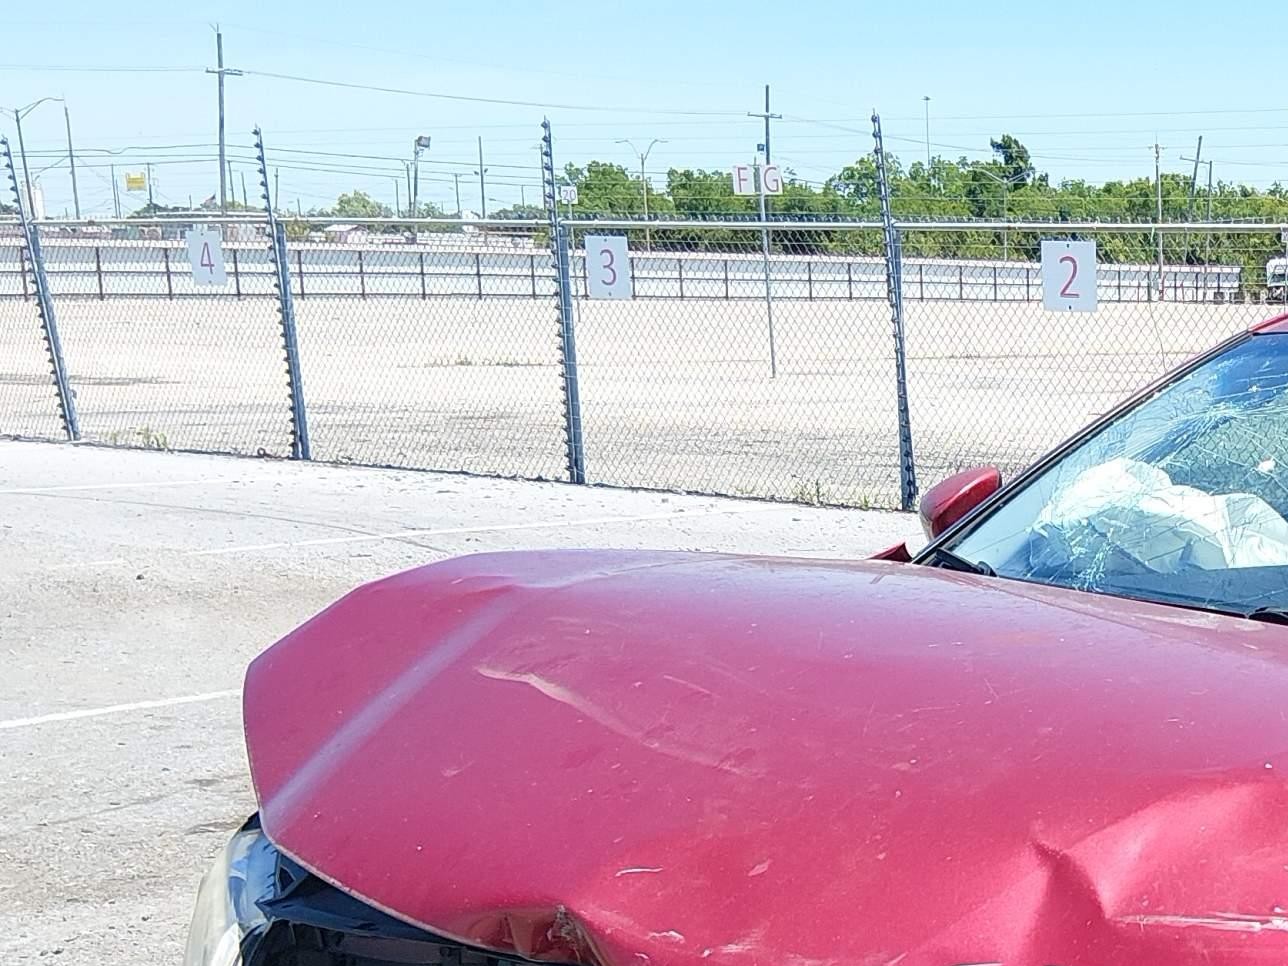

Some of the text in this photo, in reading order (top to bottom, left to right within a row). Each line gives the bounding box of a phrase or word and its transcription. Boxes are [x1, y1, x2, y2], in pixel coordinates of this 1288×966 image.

[737, 166, 748, 192] F
[763, 166, 779, 192] G
[200, 241, 215, 275] 4
[599, 248, 617, 286] 3
[1059, 255, 1080, 299] 2
